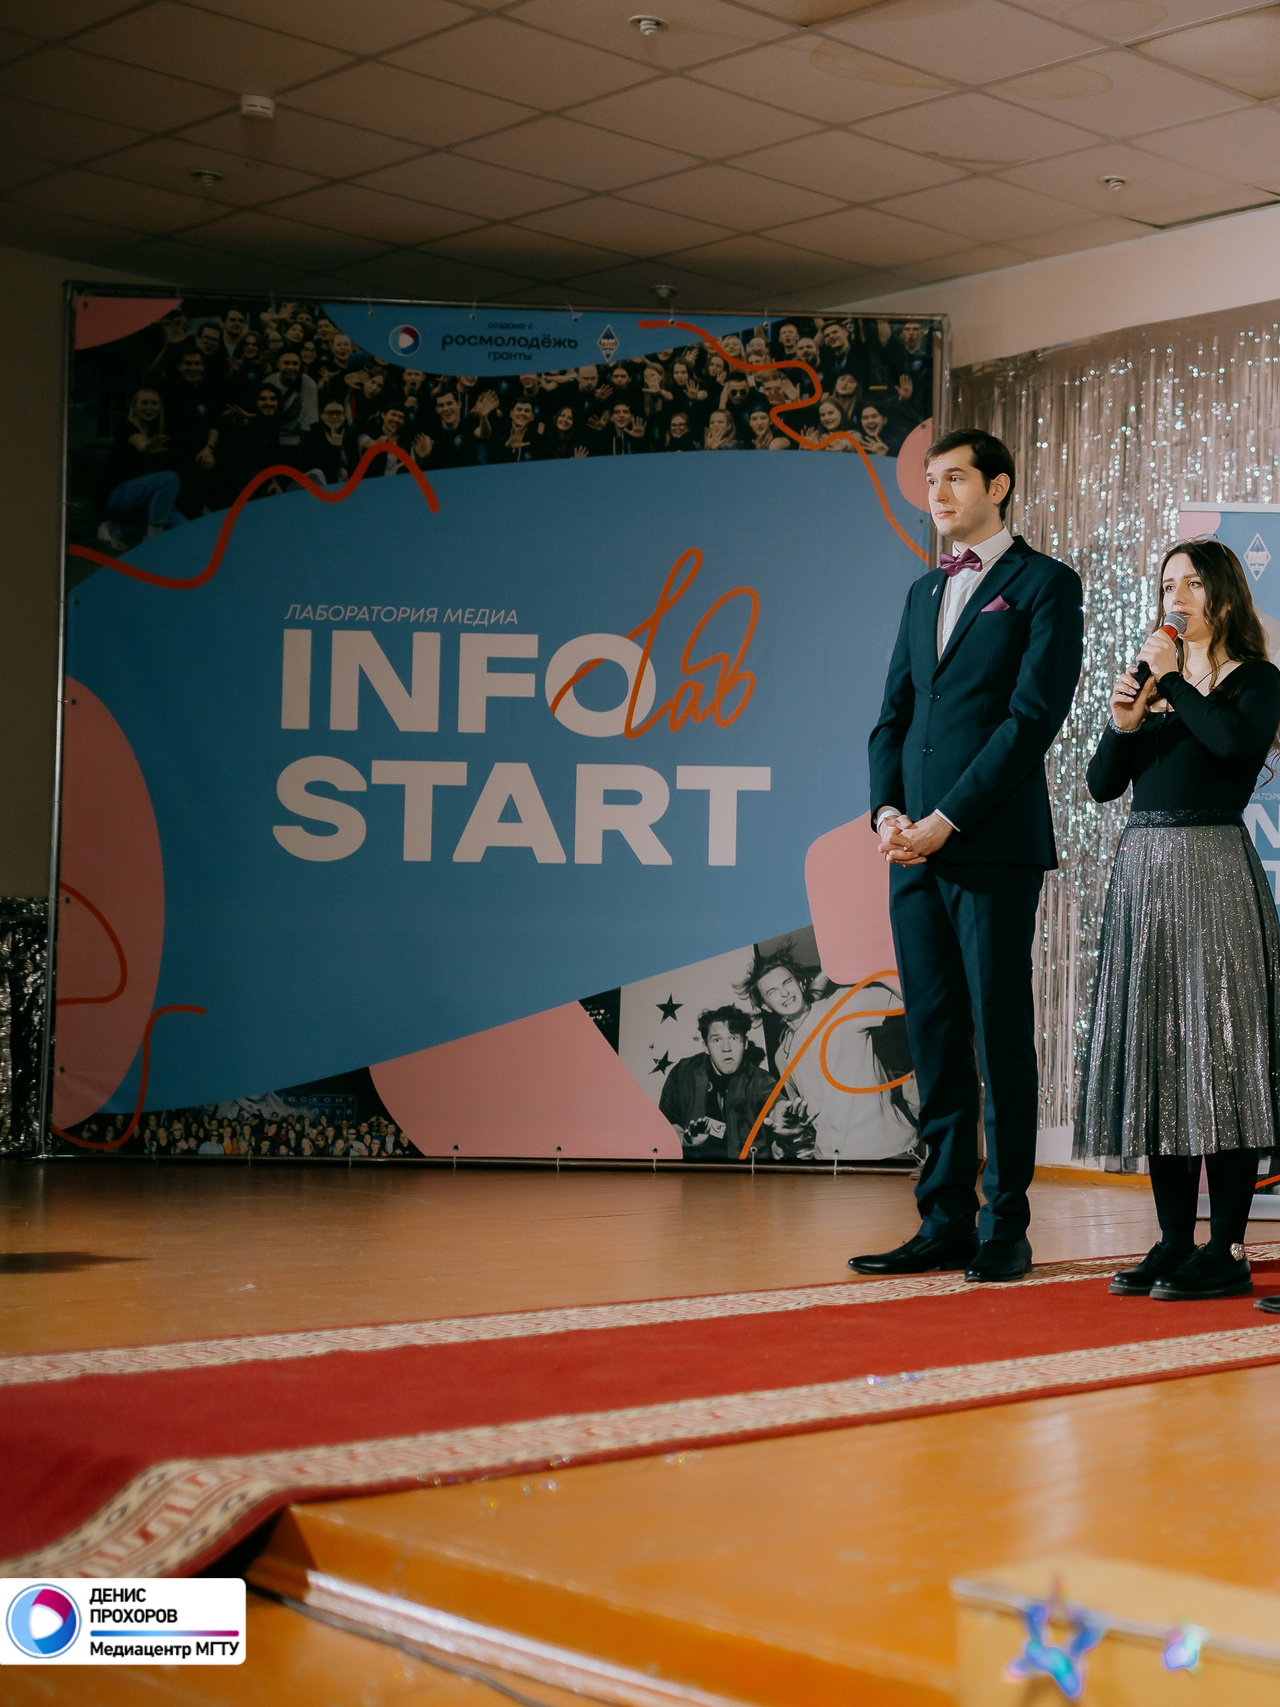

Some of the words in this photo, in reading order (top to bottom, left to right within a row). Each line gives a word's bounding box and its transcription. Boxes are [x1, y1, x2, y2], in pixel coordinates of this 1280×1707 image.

[441, 334, 578, 350] росмолодёжь
[487, 351, 533, 362] гранты
[283, 604, 438, 623] ЛАБОРАТОРИЯ
[442, 608, 519, 627] МЕДИА
[280, 629, 657, 738] INFO
[272, 755, 772, 866] START
